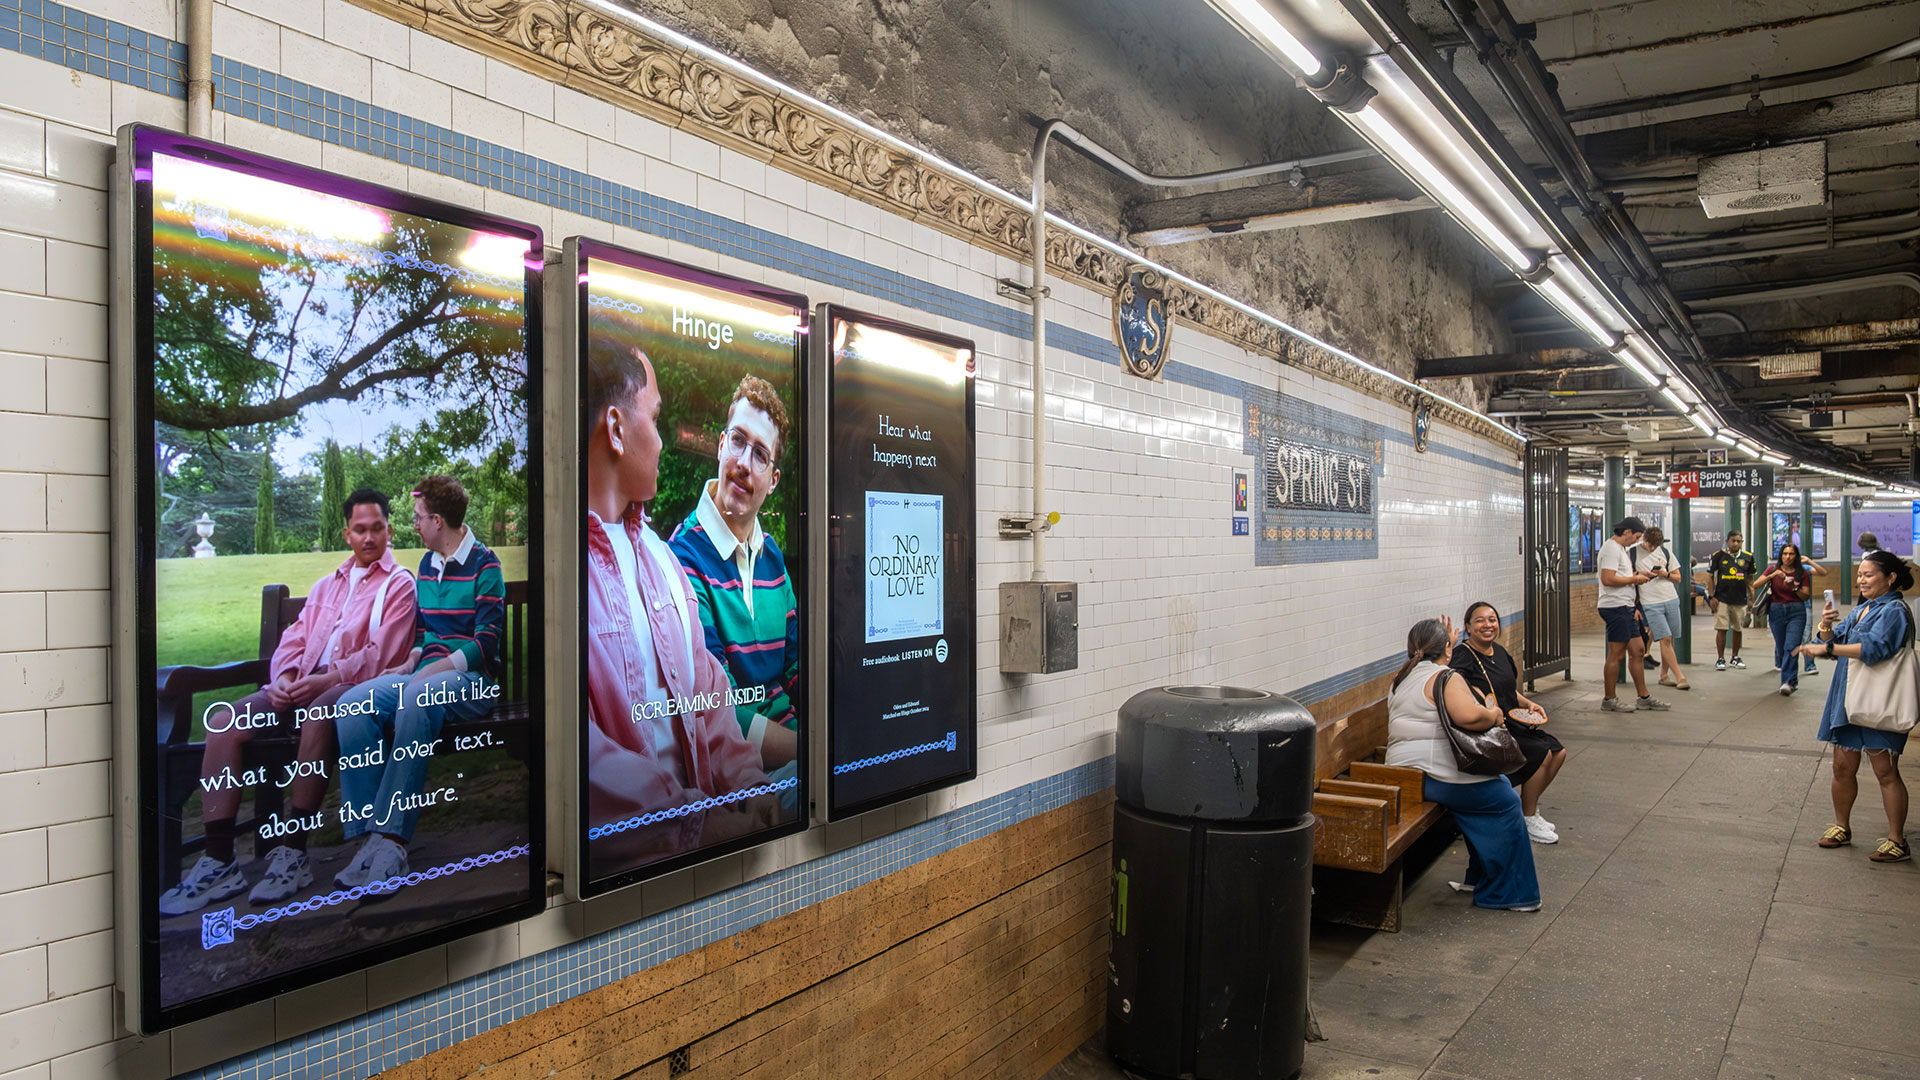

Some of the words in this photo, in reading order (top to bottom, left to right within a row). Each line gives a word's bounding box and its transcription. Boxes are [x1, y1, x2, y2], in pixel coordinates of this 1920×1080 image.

[672, 307, 734, 350] Hinge
[879, 414, 905, 437] Hear
[908, 424, 932, 441] what
[873, 443, 913, 469] happens
[915, 455, 937, 467] next
[1275, 446, 1339, 506] SPRING
[1347, 458, 1365, 508] ST
[1670, 471, 1698, 484] Exit
[1699, 471, 1731, 482] Spring
[1735, 469, 1747, 478] St
[1750, 468, 1759, 478] &
[1699, 479, 1747, 489] Lafayette
[1751, 477, 1763, 487] St
[892, 535, 920, 555] NO
[869, 555, 940, 579] ORDINARY
[887, 576, 925, 598] LOVE
[862, 657, 875, 666] Free
[874, 653, 900, 664] audiobook
[901, 650, 923, 660] LISTEN
[923, 648, 933, 657] ON
[202, 701, 280, 734] Oden
[294, 688, 380, 729] paused,
[416, 676, 467, 708] didn't
[471, 677, 500, 700] like
[631, 692, 721, 724] (SCREAMING
[724, 684, 766, 707] INSIDE)
[200, 766, 267, 793] what
[275, 760, 329, 788] you
[338, 739, 384, 771] said
[393, 739, 443, 761] over
[259, 812, 324, 839] about
[338, 801, 374, 823] the
